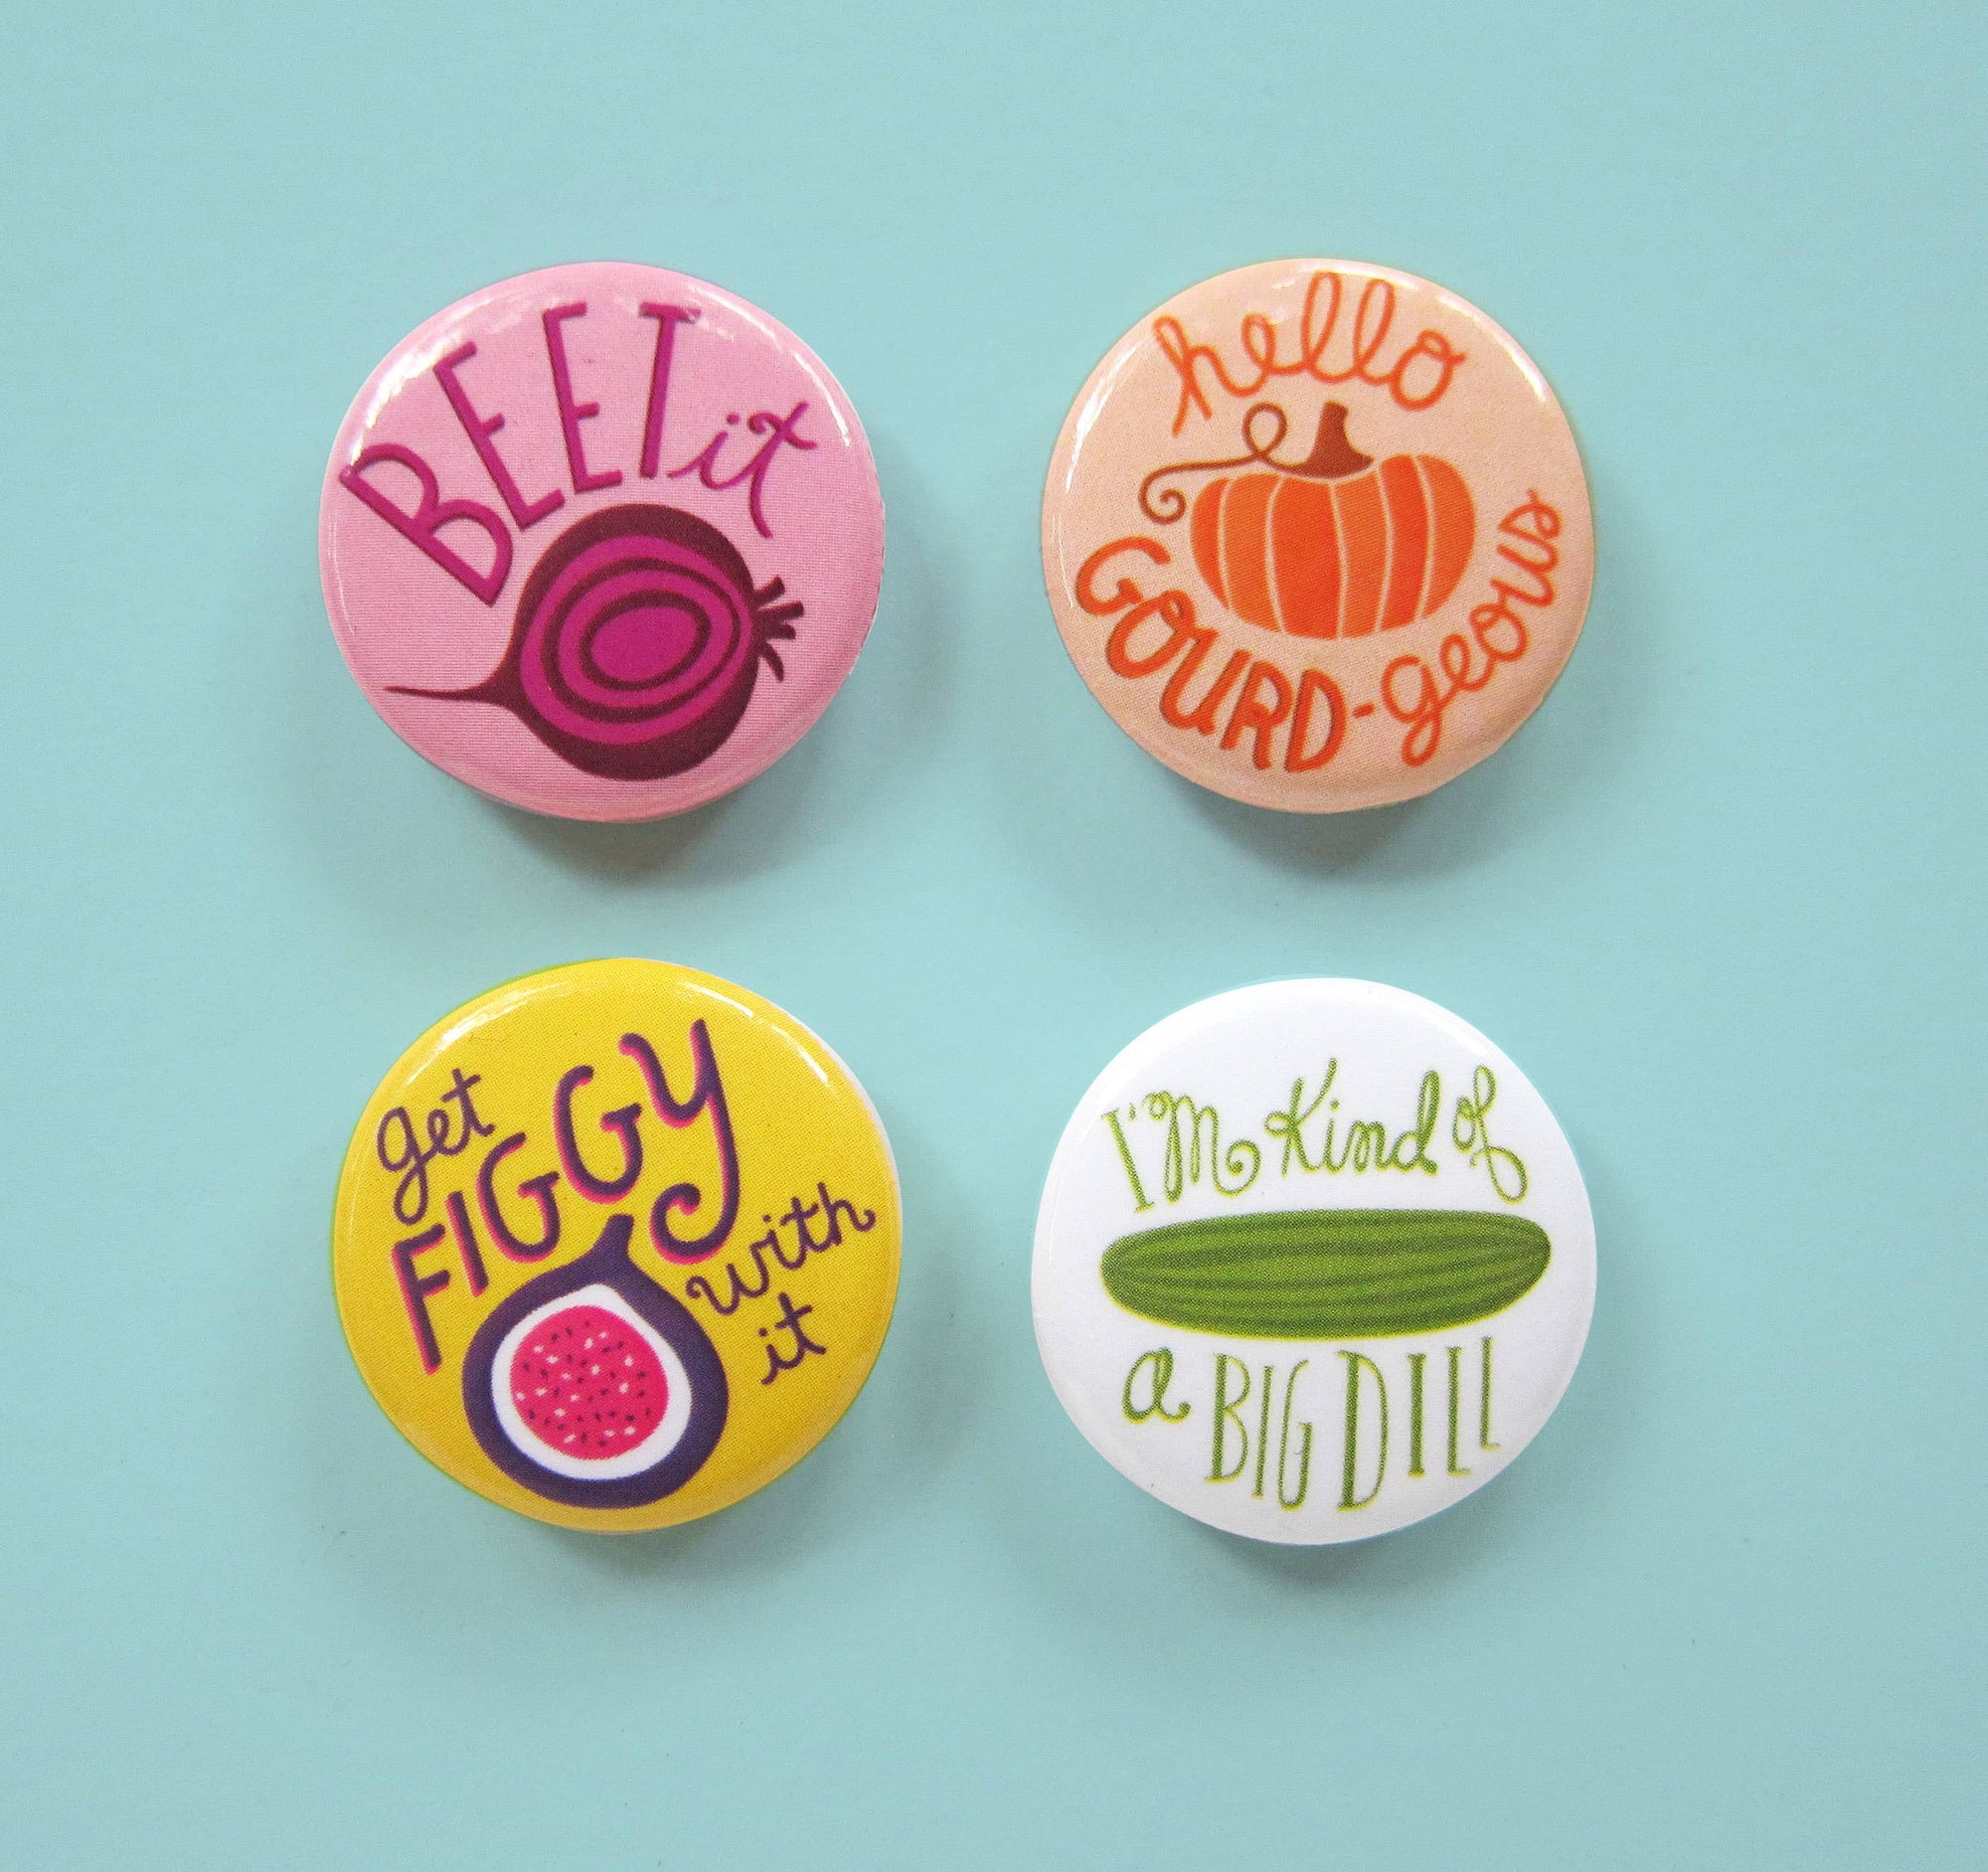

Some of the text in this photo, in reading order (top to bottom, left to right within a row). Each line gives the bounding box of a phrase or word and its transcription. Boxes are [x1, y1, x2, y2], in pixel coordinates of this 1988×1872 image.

[1153, 270, 1467, 436] hello
[339, 301, 818, 607] BEET it
[1075, 489, 1564, 773] GOURD-geous
[377, 1069, 495, 1226] get
[391, 1019, 741, 1376] FIGGY
[1452, 1065, 1529, 1204] of
[686, 1182, 877, 1315] with
[759, 1291, 827, 1386] it
[1204, 1353, 1314, 1512] BIG
[1337, 1335, 1501, 1512] DILL
